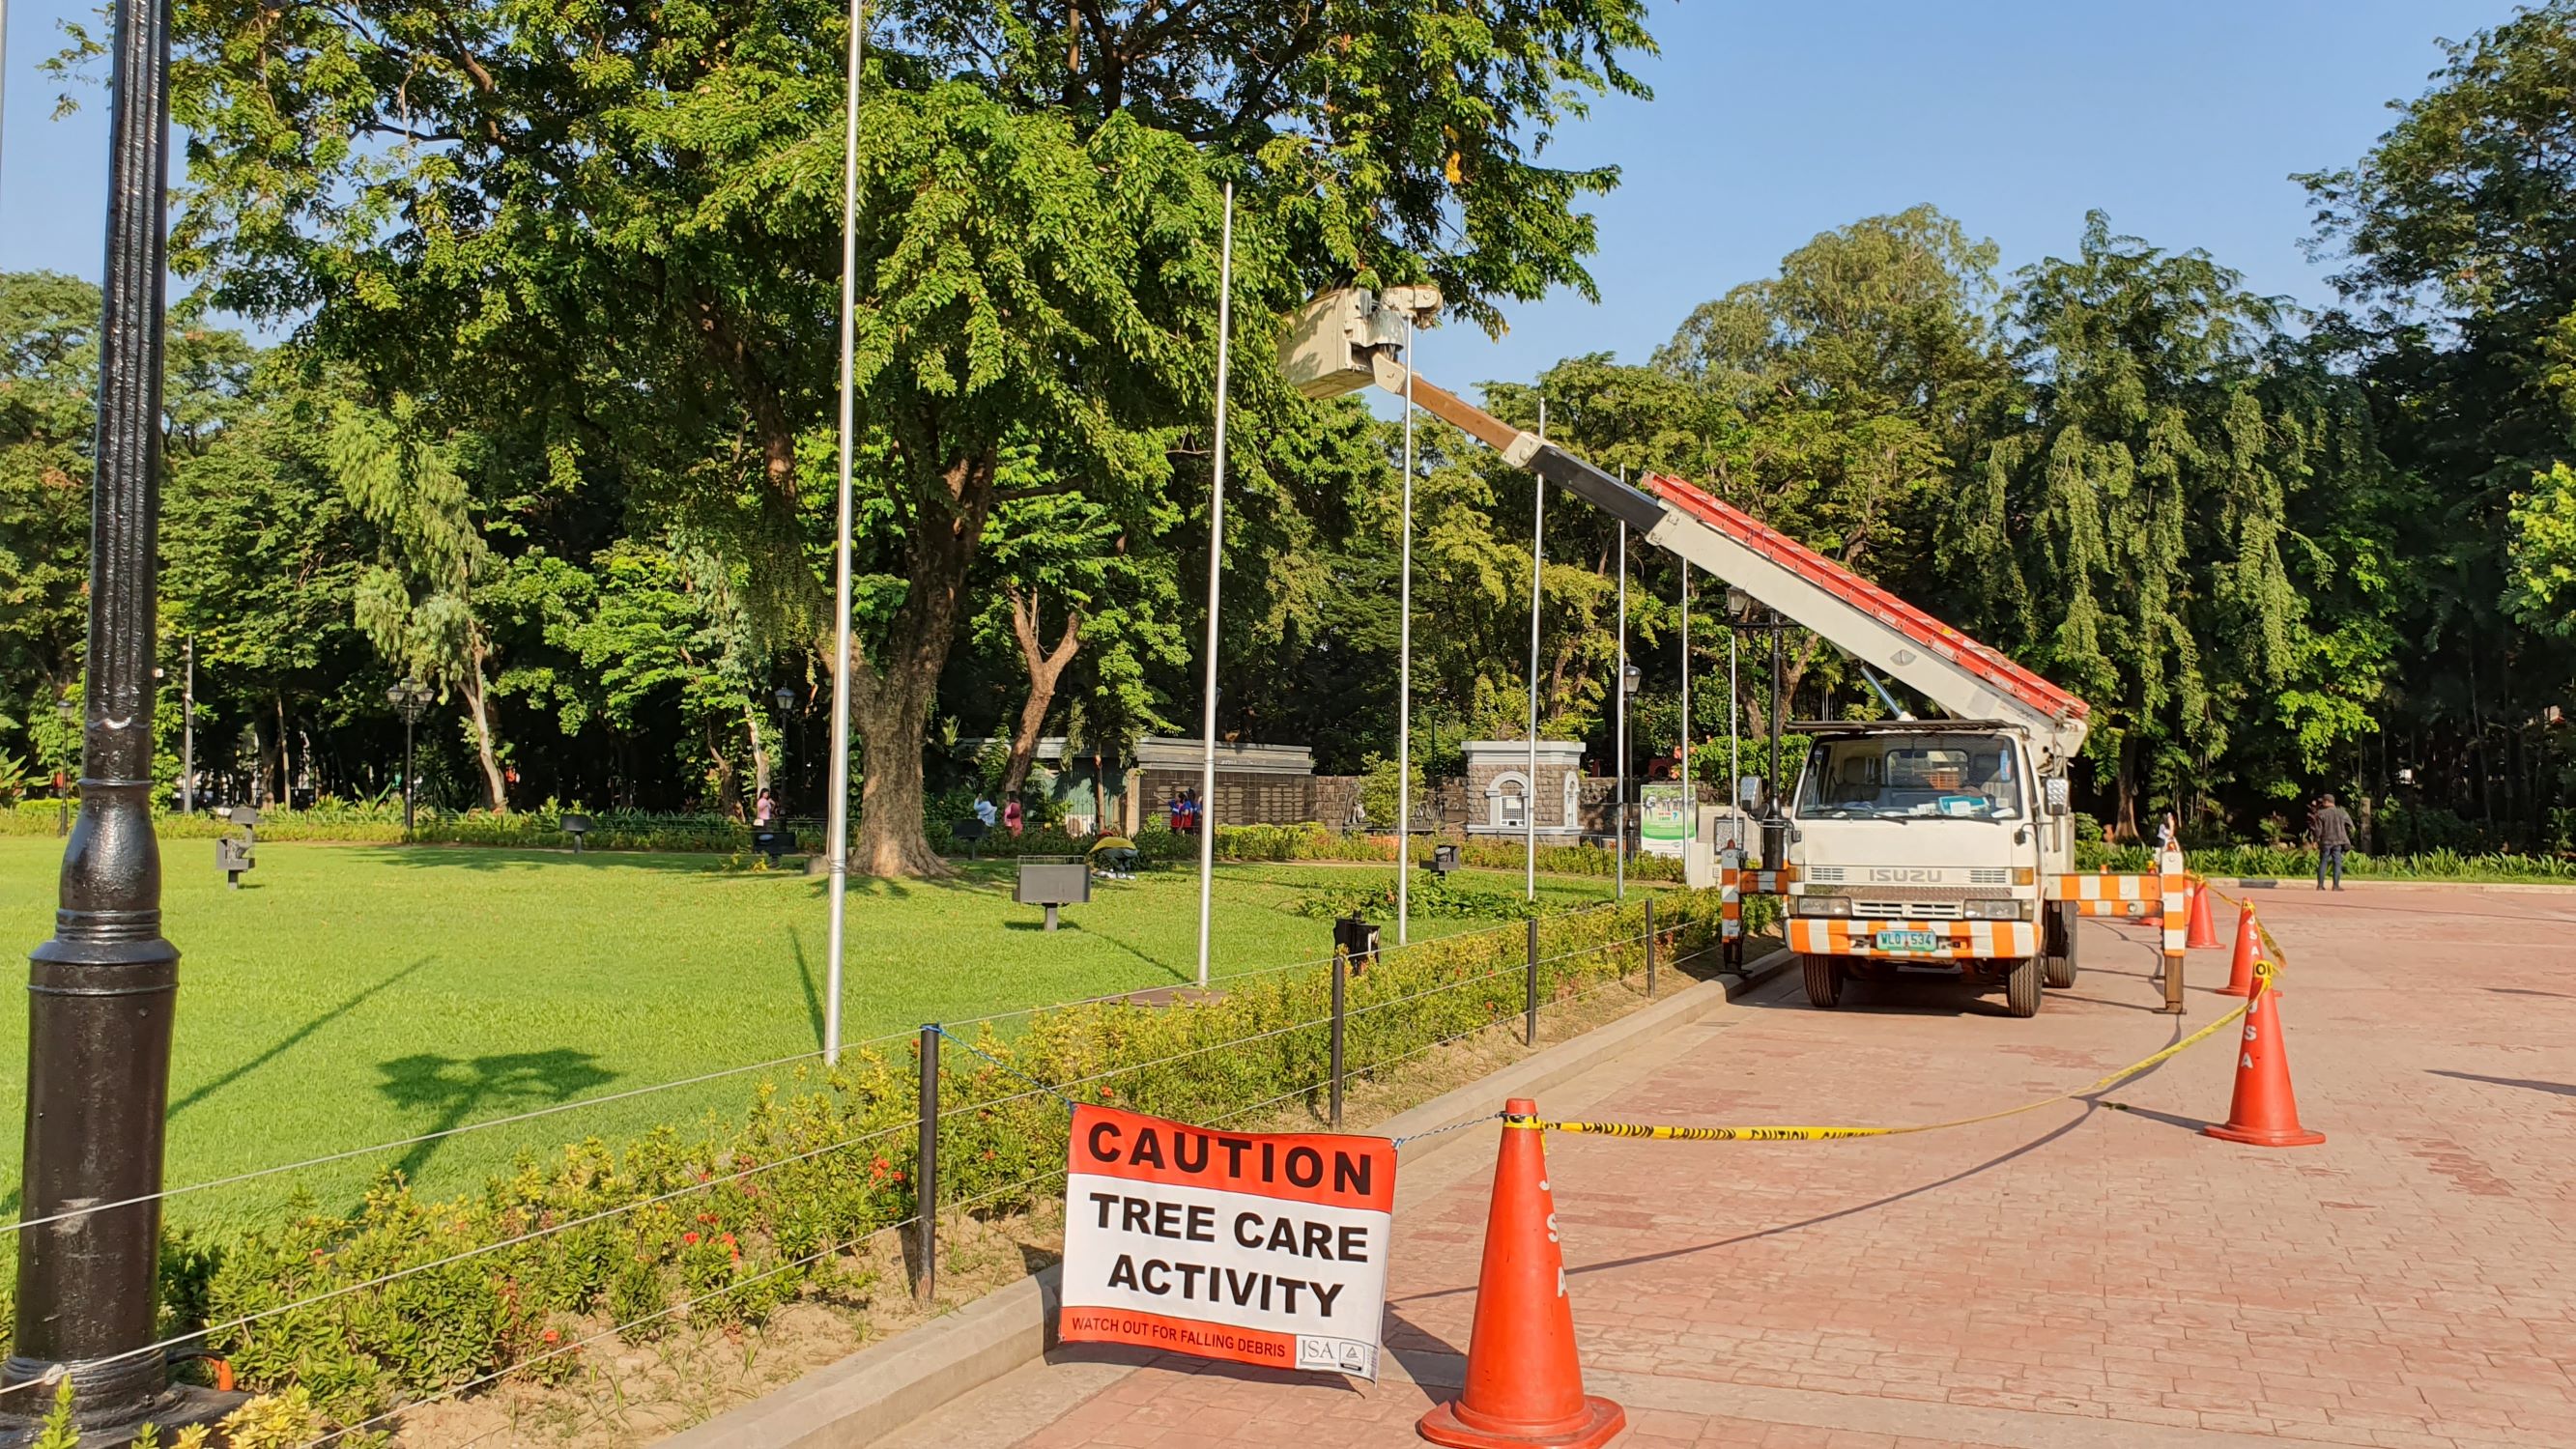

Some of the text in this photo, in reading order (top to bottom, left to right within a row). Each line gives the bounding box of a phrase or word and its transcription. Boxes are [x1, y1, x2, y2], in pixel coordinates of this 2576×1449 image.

[1869, 868, 1942, 883] ISUZU
[1910, 933, 1932, 946] 534
[1088, 1122, 1372, 1196] CAUTION
[1089, 1192, 1368, 1264] TREE CARE
[1106, 1254, 1345, 1318] ACTIVITY
[1072, 1317, 1286, 1358] WATCH OUT FOR FALLING DEBRIS
[1300, 1340, 1333, 1362] JSA
